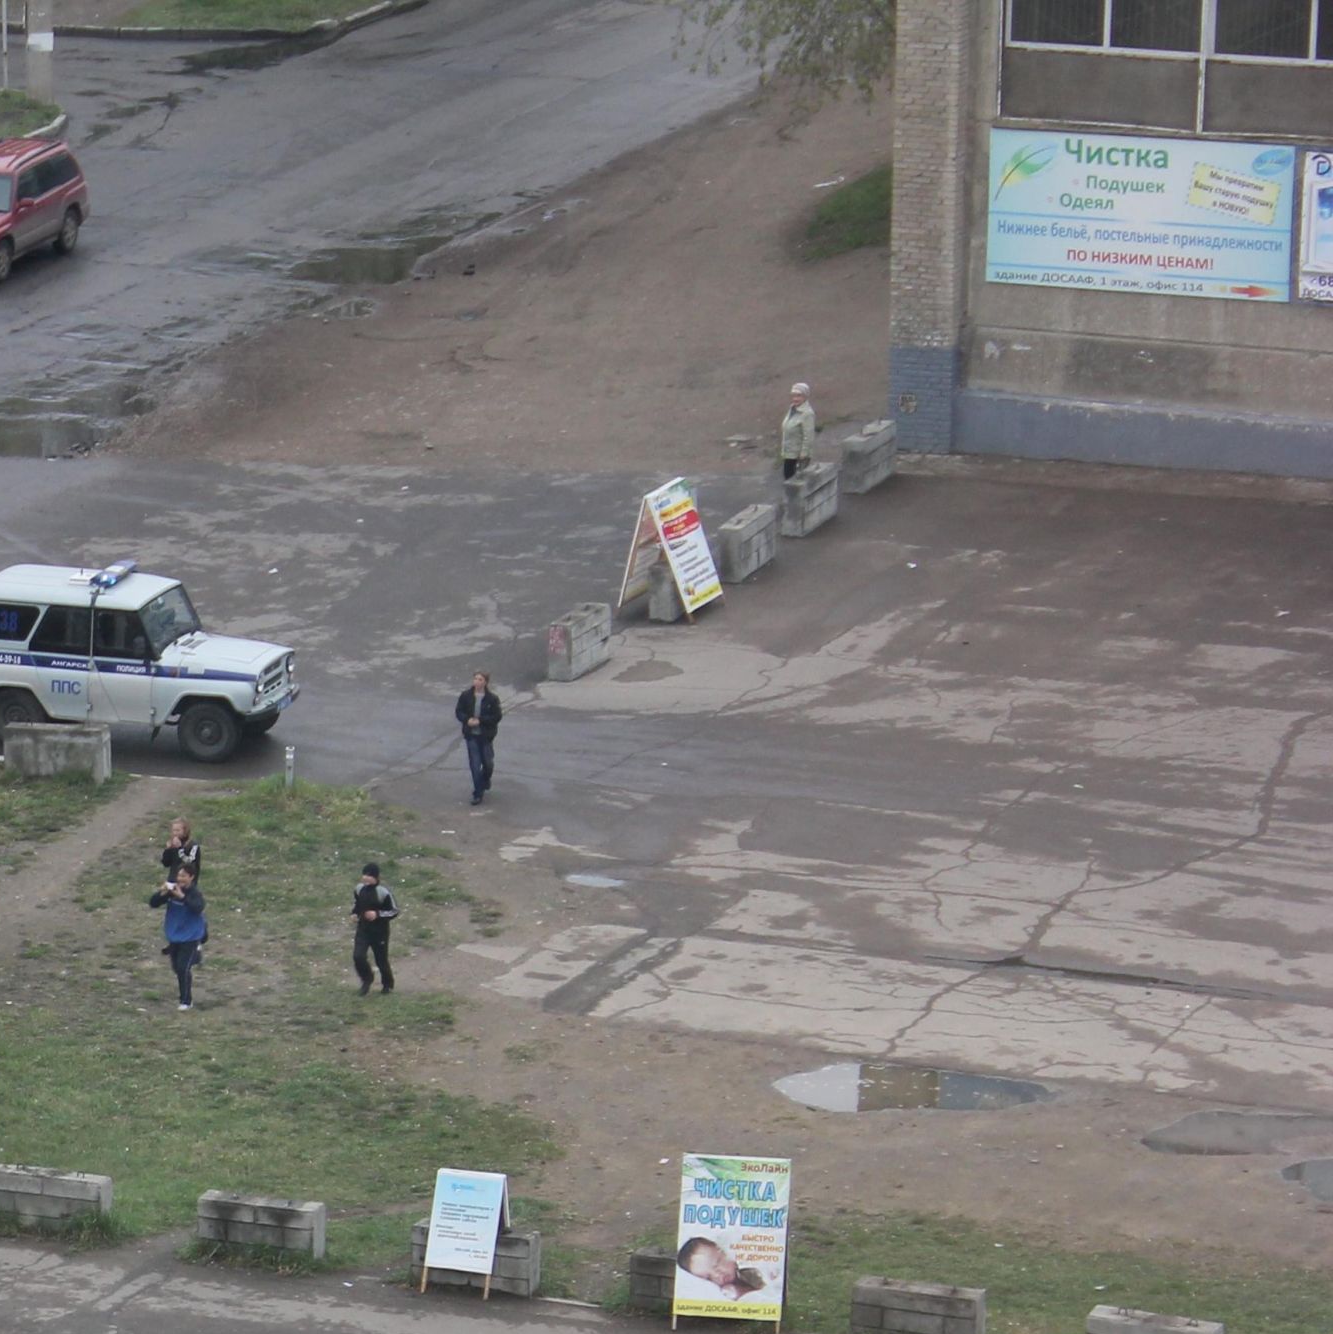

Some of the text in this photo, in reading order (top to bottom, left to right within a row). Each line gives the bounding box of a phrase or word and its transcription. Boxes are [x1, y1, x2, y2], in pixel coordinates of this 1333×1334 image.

[1064, 137, 1170, 169] Чистка
[1086, 174, 1165, 195] Подушек
[1059, 193, 1115, 211] Одеял
[997, 219, 1283, 252] Нижнее бельё, постельные принадлежности
[1066, 248, 1214, 271] ПО НИЗКИМ ЦЕНАМ!
[994, 271, 1038, 282] здание
[1040, 272, 1097, 286] ДОСААФ,
[1146, 280, 1178, 292] офис
[1182, 282, 1204, 292] 114
[116, 664, 147, 674] ПОЛИЦИЯ
[51, 679, 82, 695] ППС
[740, 1162, 789, 1174] ЭкоЛайн
[693, 1177, 777, 1202] ЧИСТКА
[683, 1203, 785, 1229] ПОДУШЕК
[741, 1233, 774, 1242] БЫСТРО
